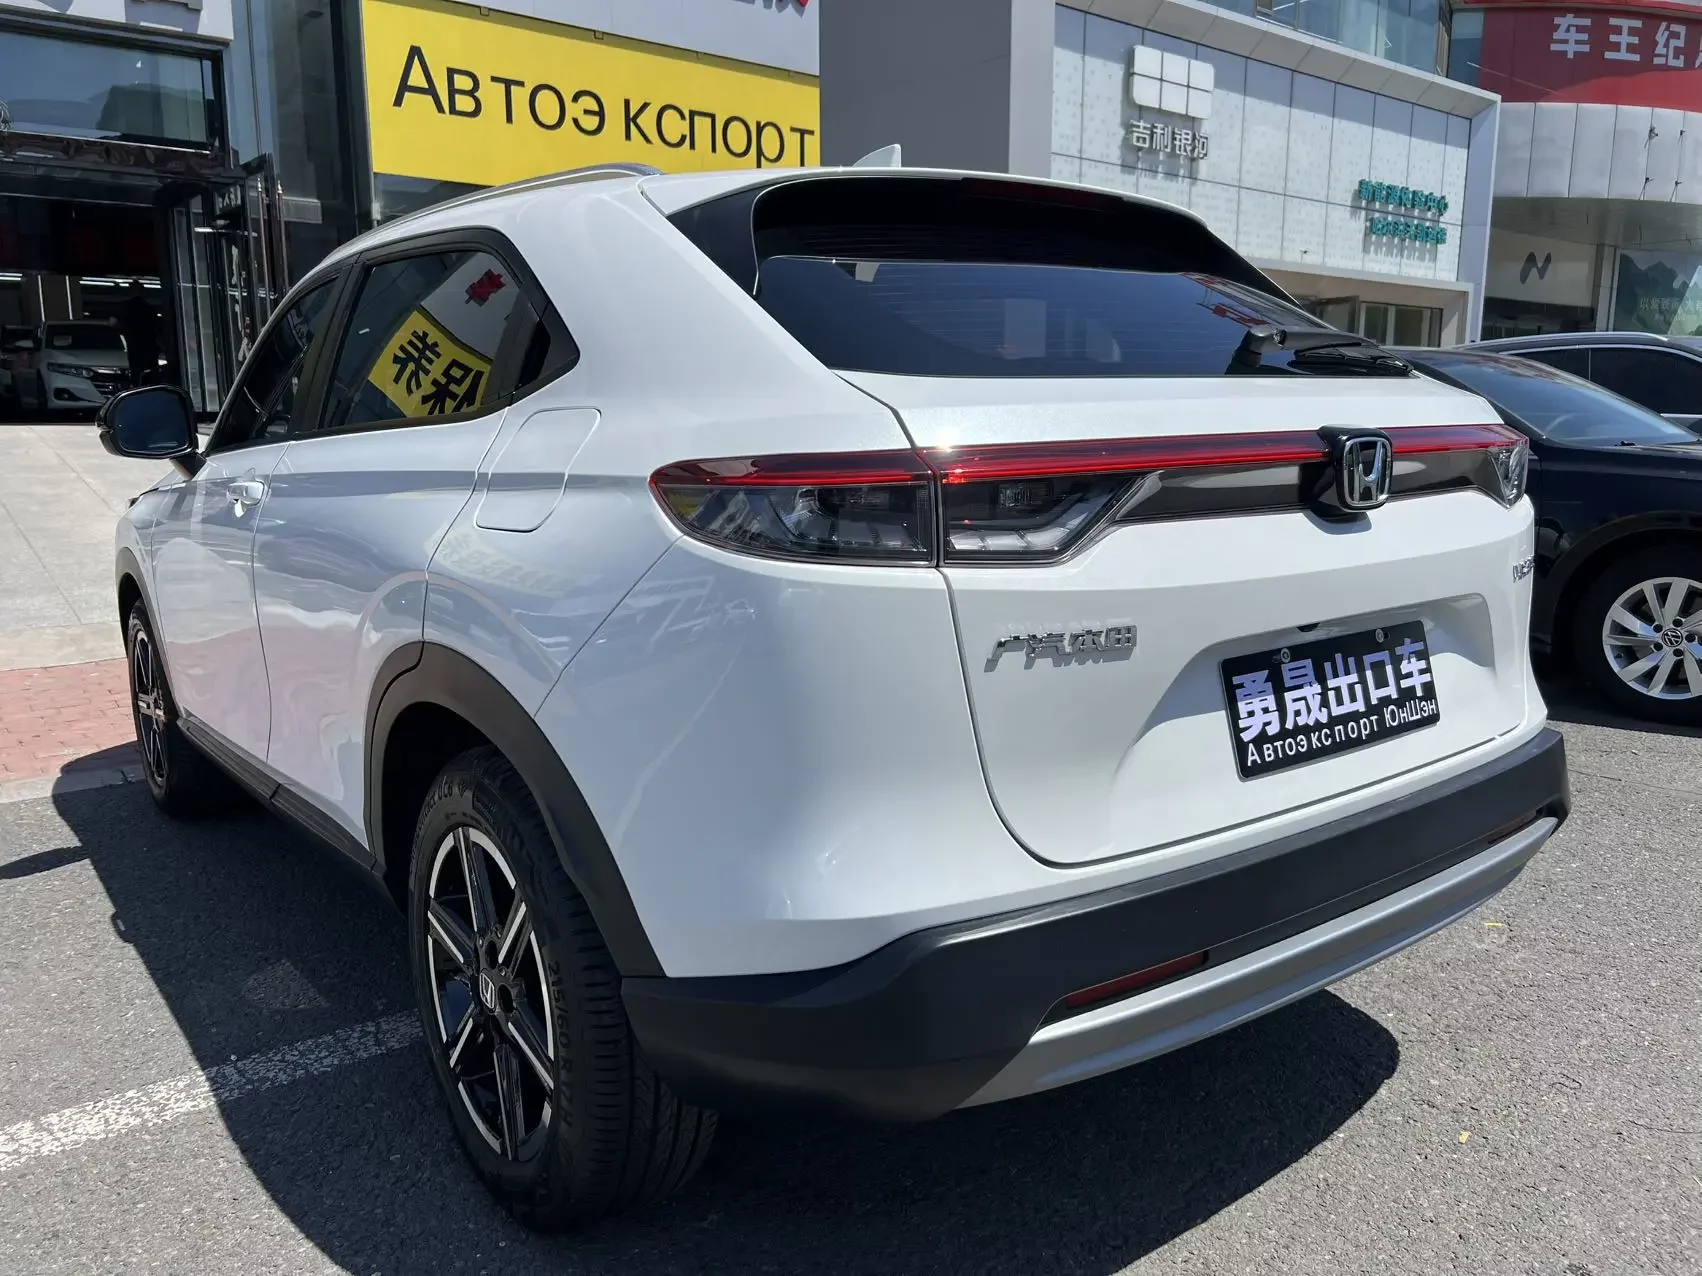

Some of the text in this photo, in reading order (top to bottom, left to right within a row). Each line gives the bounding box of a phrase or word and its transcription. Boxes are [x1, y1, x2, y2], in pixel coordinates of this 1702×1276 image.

[1550, 13, 1702, 68] 车王纪
[1129, 119, 1209, 160] 吉利银河
[1232, 637, 1432, 742] 勇晟出口车
